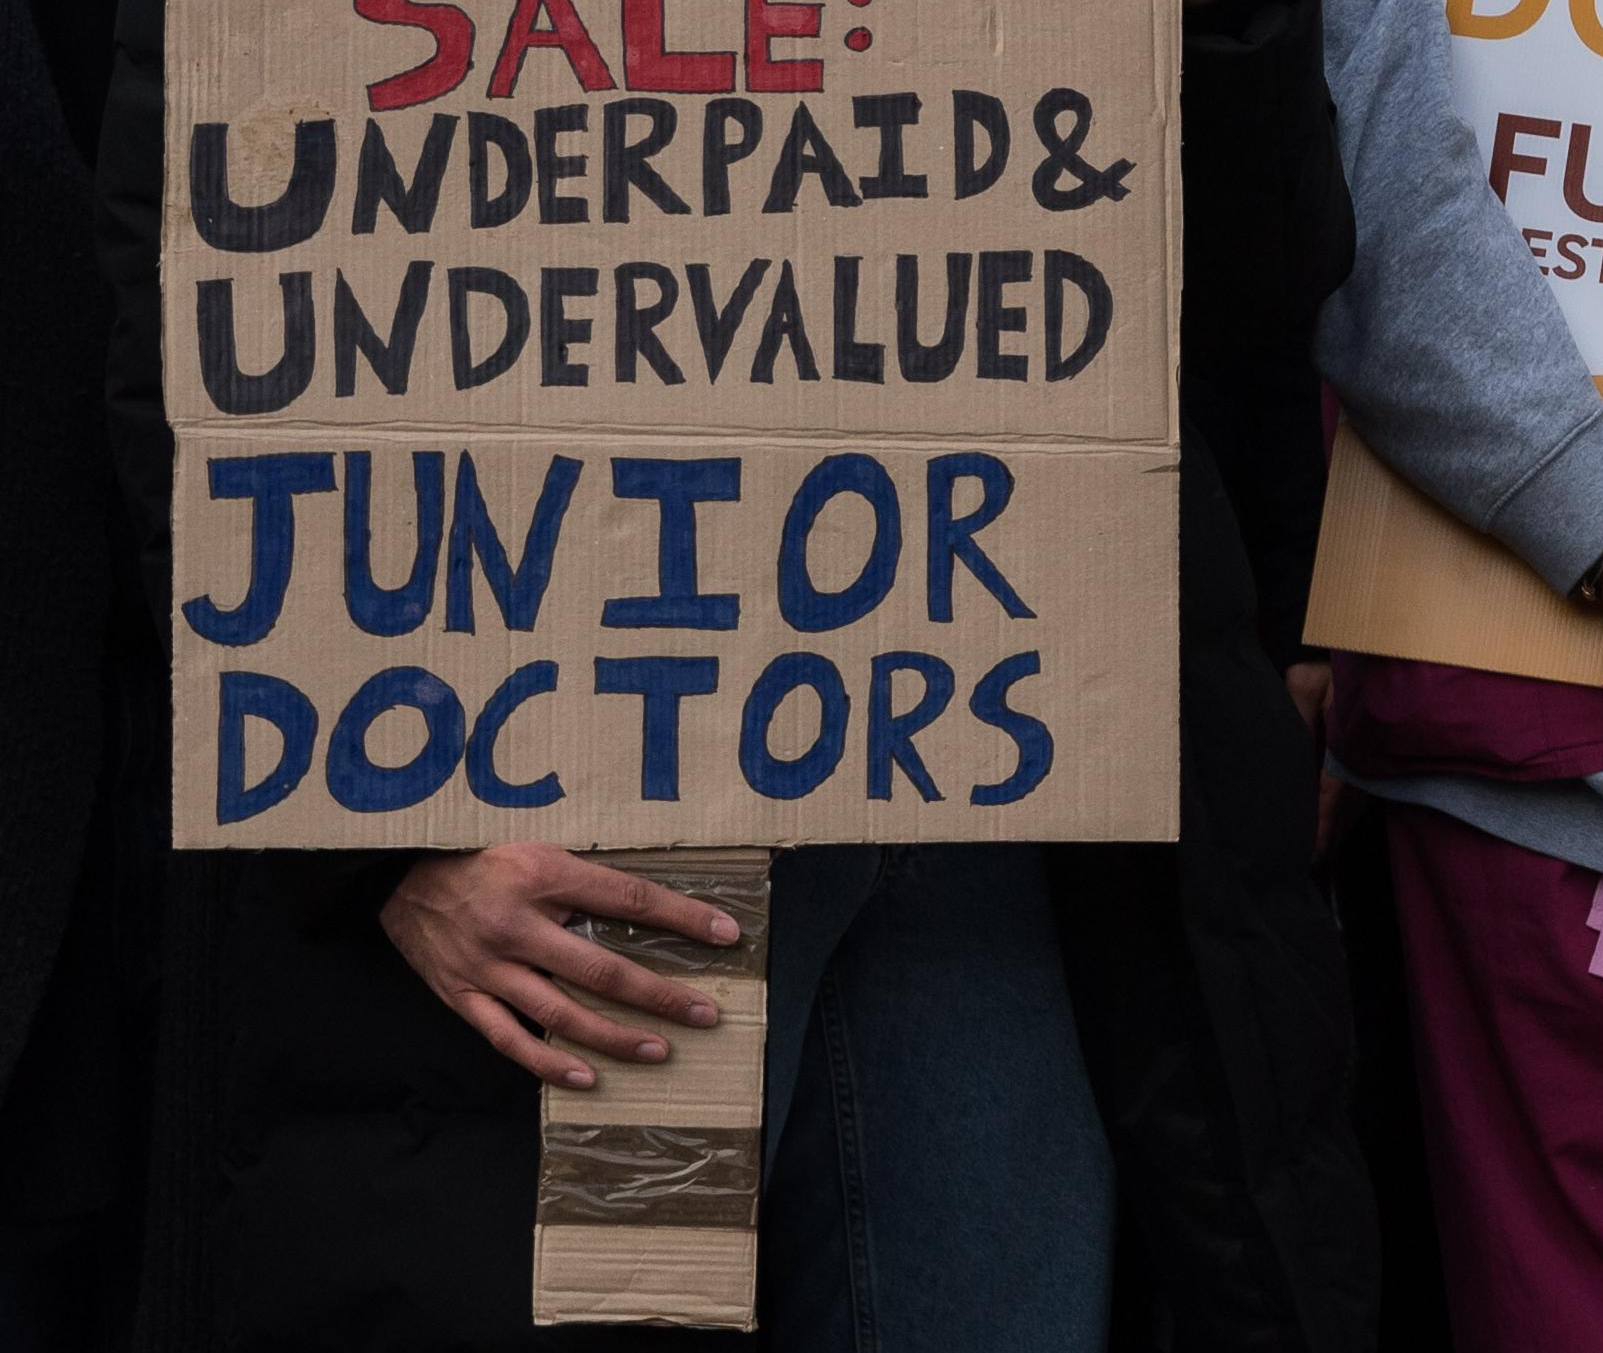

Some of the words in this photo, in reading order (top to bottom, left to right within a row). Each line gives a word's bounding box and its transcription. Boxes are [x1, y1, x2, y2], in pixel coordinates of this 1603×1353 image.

[190, 89, 1011, 253] UNDERPAID
[1031, 88, 1138, 212] &
[197, 250, 1114, 416] UNDERVALUED
[181, 448, 1038, 647] JUNIOR
[216, 649, 1054, 826] DOCTORS
